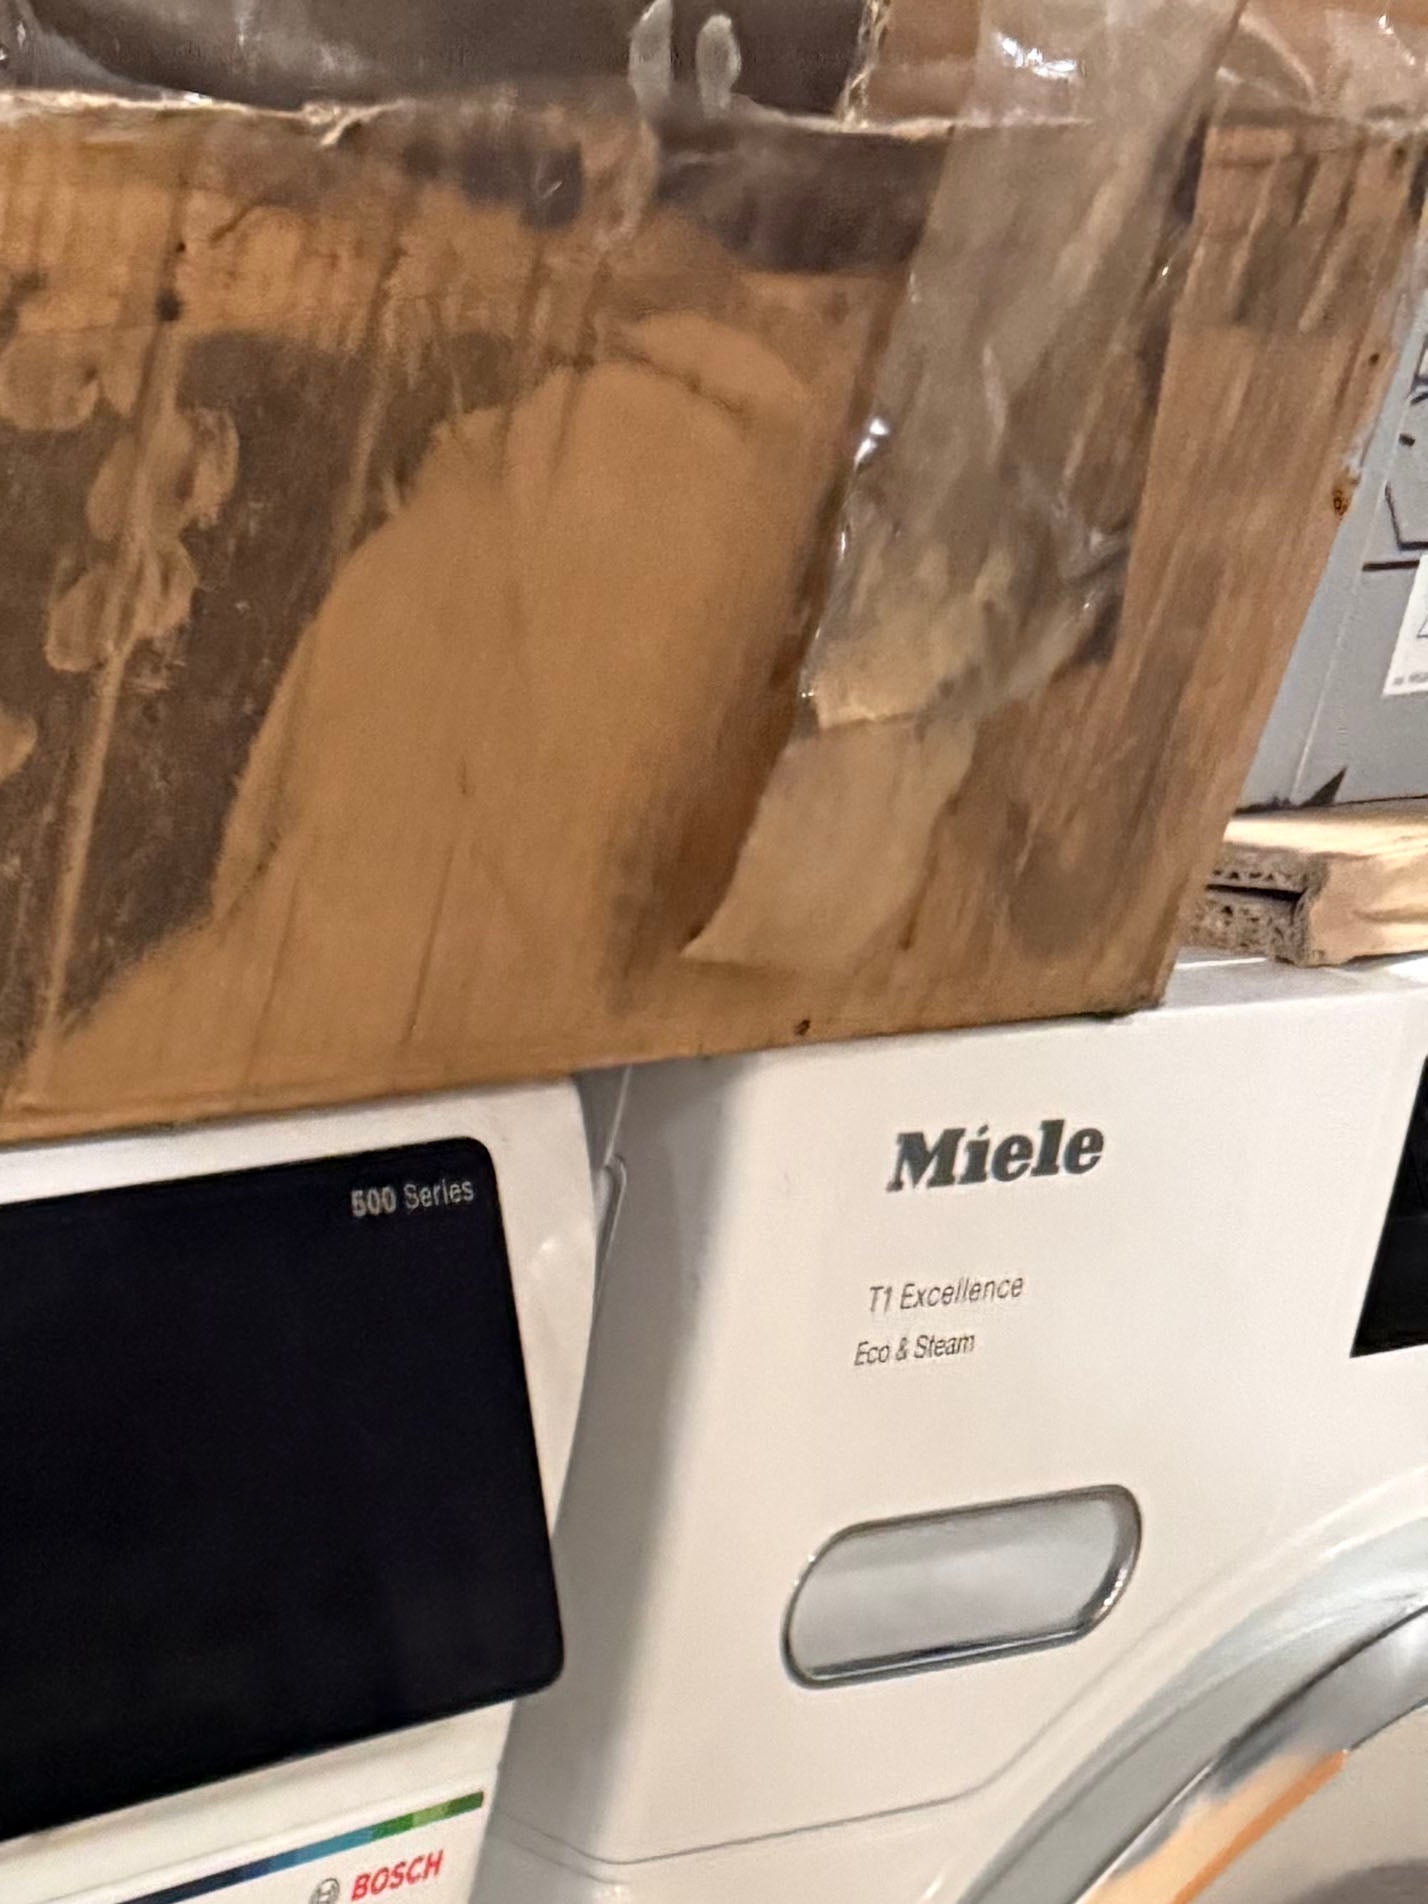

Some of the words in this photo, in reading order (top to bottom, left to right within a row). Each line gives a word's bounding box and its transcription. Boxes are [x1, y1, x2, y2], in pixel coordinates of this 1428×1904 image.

[886, 1119, 1104, 1193] Miele
[404, 1179, 474, 1209] Series
[870, 1285, 892, 1312] T1
[900, 1277, 1024, 1310] Excellence
[854, 1341, 890, 1366] Eco
[895, 1336, 908, 1361] &
[913, 1334, 976, 1360] Steam
[350, 1849, 444, 1902] BOSCH
